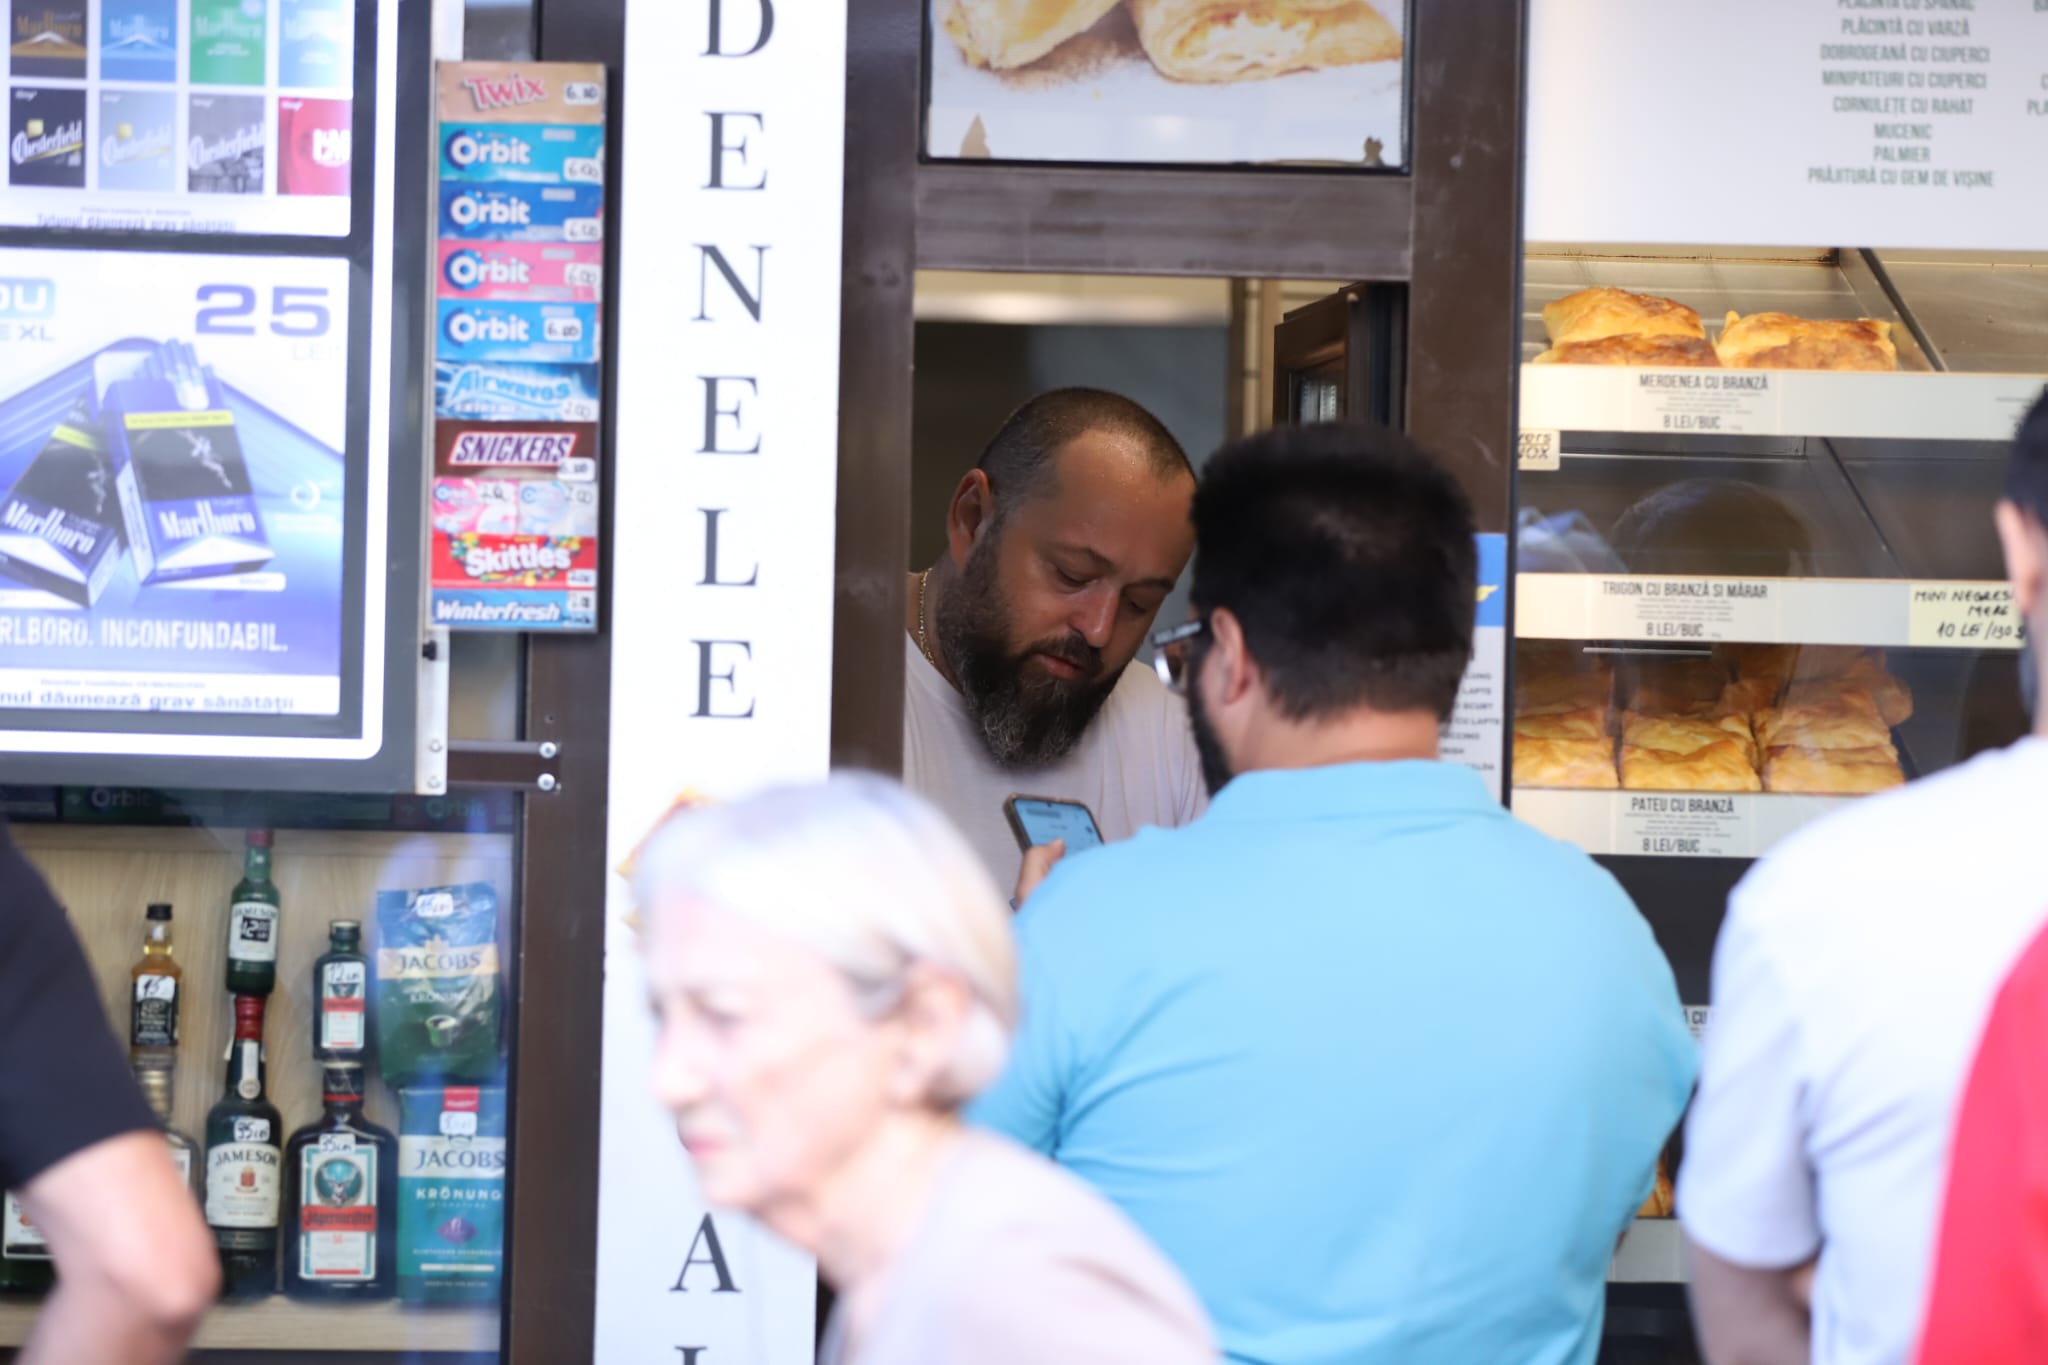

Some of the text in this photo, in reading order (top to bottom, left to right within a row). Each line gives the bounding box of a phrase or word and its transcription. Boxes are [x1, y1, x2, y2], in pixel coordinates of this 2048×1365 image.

[1907, 19, 1924, 36] CU
[1911, 46, 1928, 62] CU
[1908, 72, 1925, 88] CU
[466, 73, 546, 108] Twix
[1911, 98, 1928, 115] CU
[1932, 98, 1973, 115] RAHAT
[1873, 123, 1932, 140] MUCENIC
[451, 135, 530, 165] Orbit
[1873, 146, 1930, 162] PALMIER
[1880, 168, 1897, 185] CU
[1901, 168, 1929, 186] GEM
[1933, 169, 1948, 186] DE
[451, 195, 530, 225] Orbit
[450, 255, 530, 284] Orbit
[195, 283, 331, 338] 25
[448, 313, 530, 343] Orbit
[1640, 374, 1700, 389] MERDENEA
[1704, 375, 1719, 389] CU
[1663, 415, 1721, 430] 8 LEI/BUC
[456, 433, 571, 463] SNICKERS
[5, 499, 97, 555] Marlboro
[158, 499, 256, 540] Marlboro
[466, 543, 571, 576] Skittles
[1603, 581, 1642, 596] TRIGON
[1646, 582, 1661, 596] CU
[1915, 590, 1946, 601] MINI
[437, 599, 561, 622] Winterfresh
[102, 618, 289, 652] INCONFUNDABIL.
[1646, 622, 1653, 636] 8
[1657, 623, 1704, 637] LEI/BUC
[1937, 621, 1956, 638] 10
[1632, 797, 1666, 812] PATEU
[1670, 798, 1685, 812] CU
[1643, 838, 1650, 851] 8
[1653, 838, 1700, 853] LEI/BUC
[396, 954, 481, 974] JACOBS
[216, 1150, 277, 1167] JAMESON
[416, 1149, 507, 1171] JACOBS
